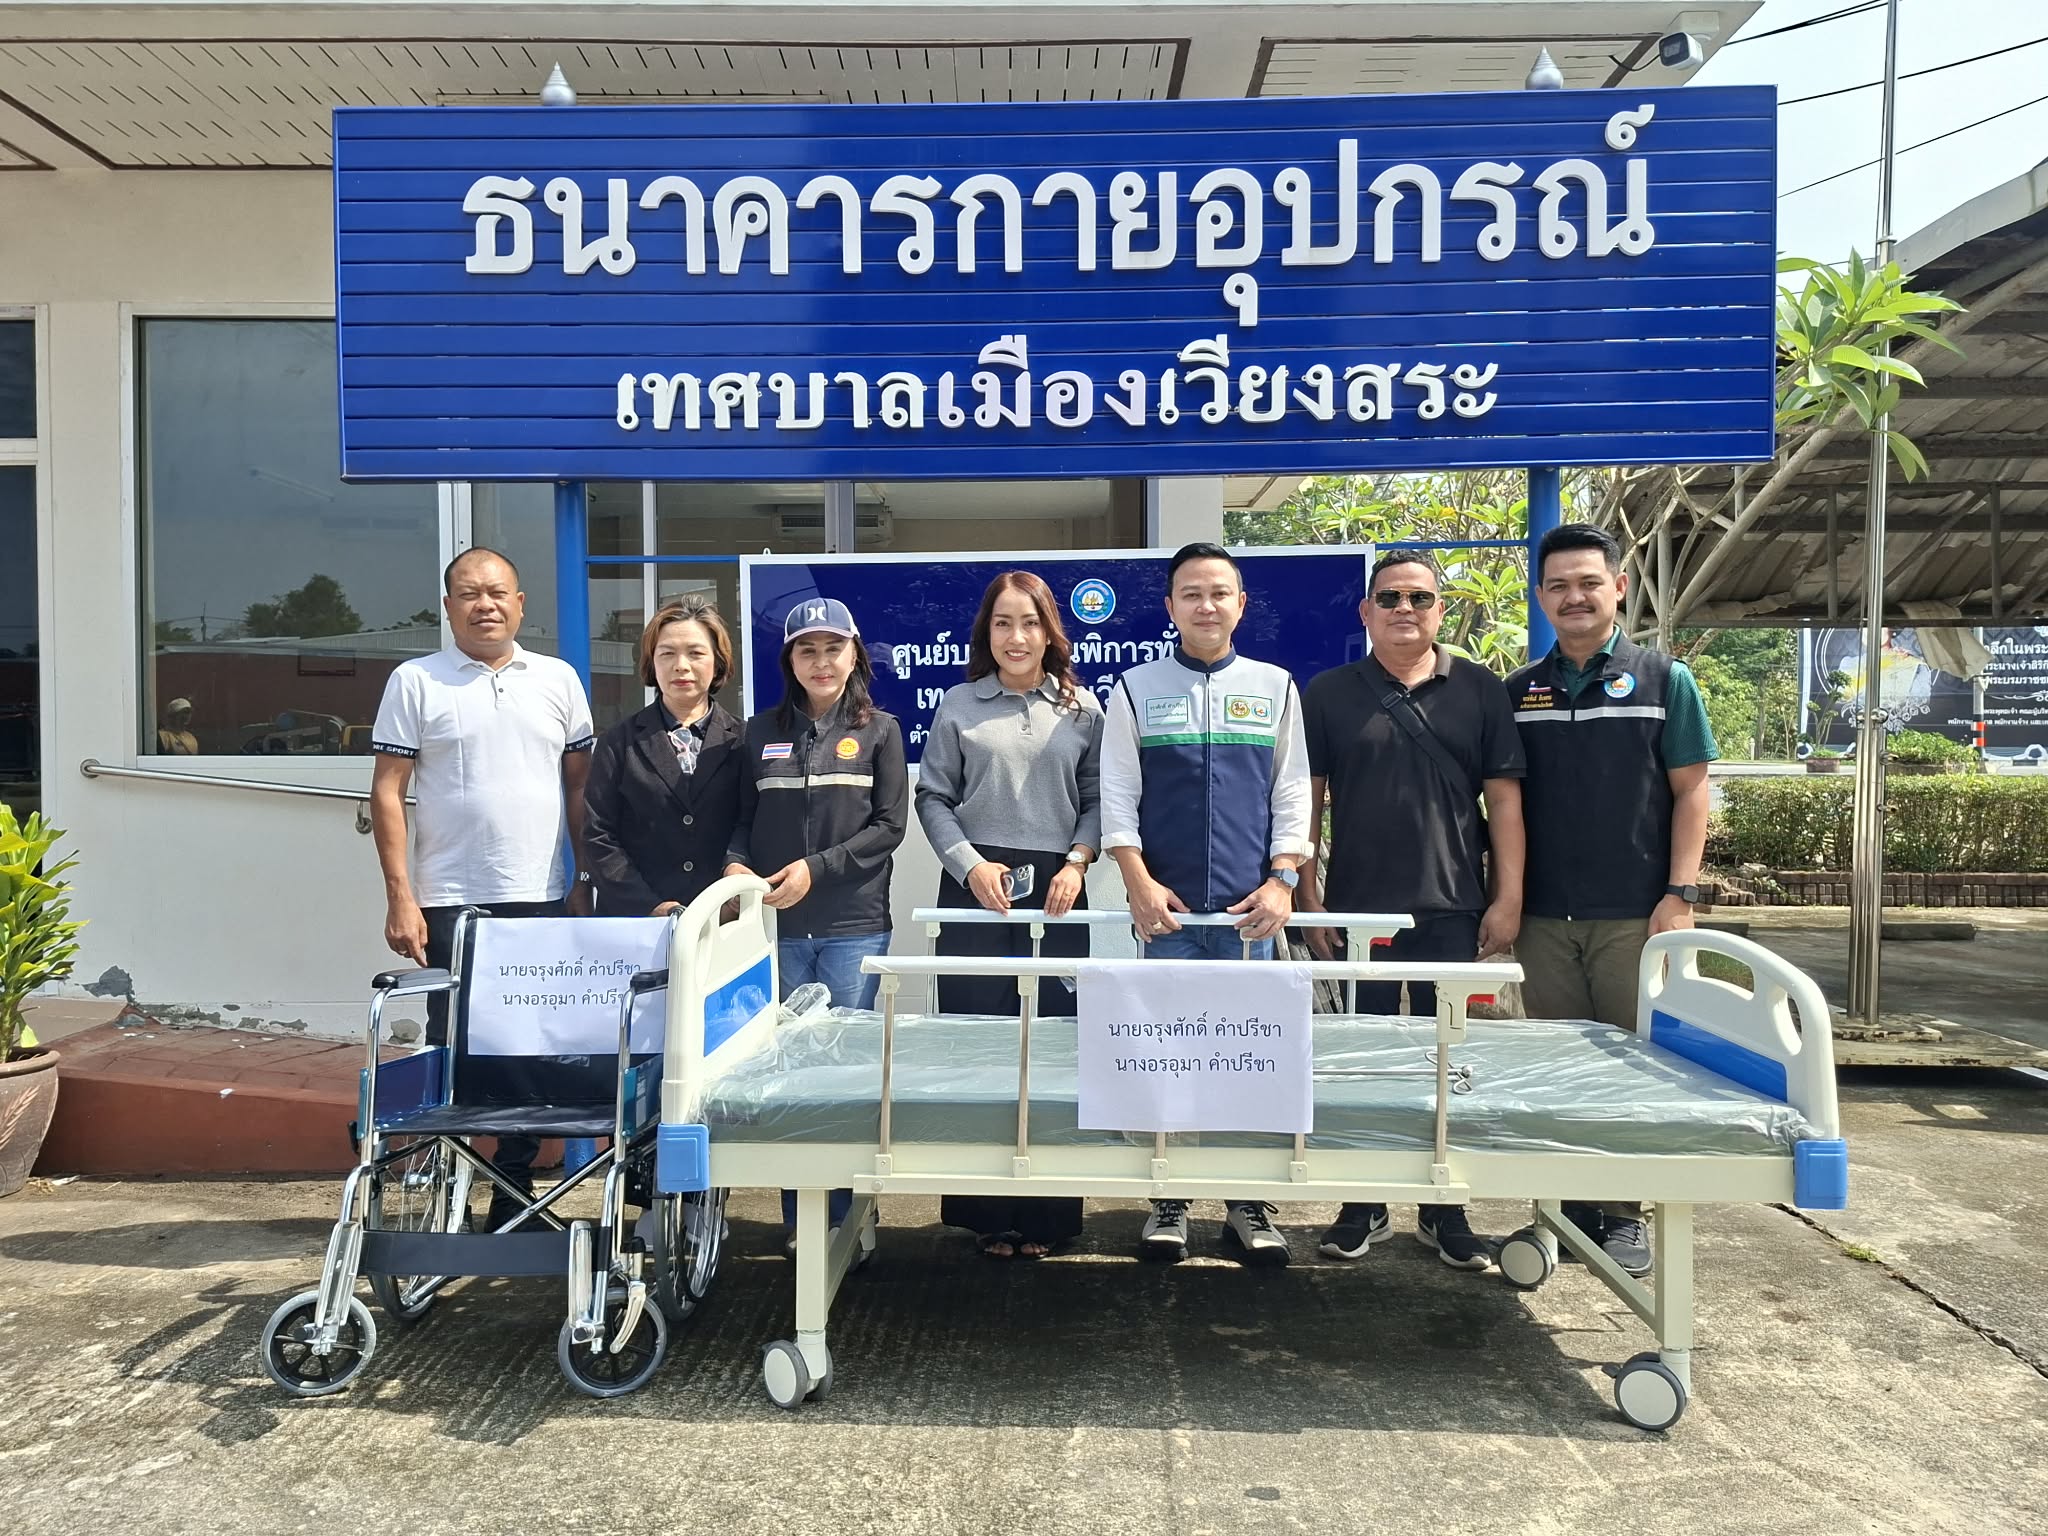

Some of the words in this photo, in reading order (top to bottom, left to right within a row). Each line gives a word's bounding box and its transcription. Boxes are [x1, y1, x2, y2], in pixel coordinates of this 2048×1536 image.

[462, 103, 1656, 328] ธนาคารกายอุปกรณ์
[616, 333, 1500, 431] เทศบาลเมืองเวียงสระ
[386, 745, 415, 756] SPORT
[499, 956, 584, 982] นายจรุงศักดิ์
[588, 958, 641, 977] คำปรีชา
[502, 993, 576, 1011] นางอรอุมา
[581, 988, 624, 1005] คำปรี
[1108, 1010, 1208, 1044] นายจรุงศักดิ์
[1215, 1016, 1282, 1038] คำปรีชา
[1115, 1055, 1201, 1079] นางอรอุมา
[1209, 1051, 1276, 1073] คำปรีชา
